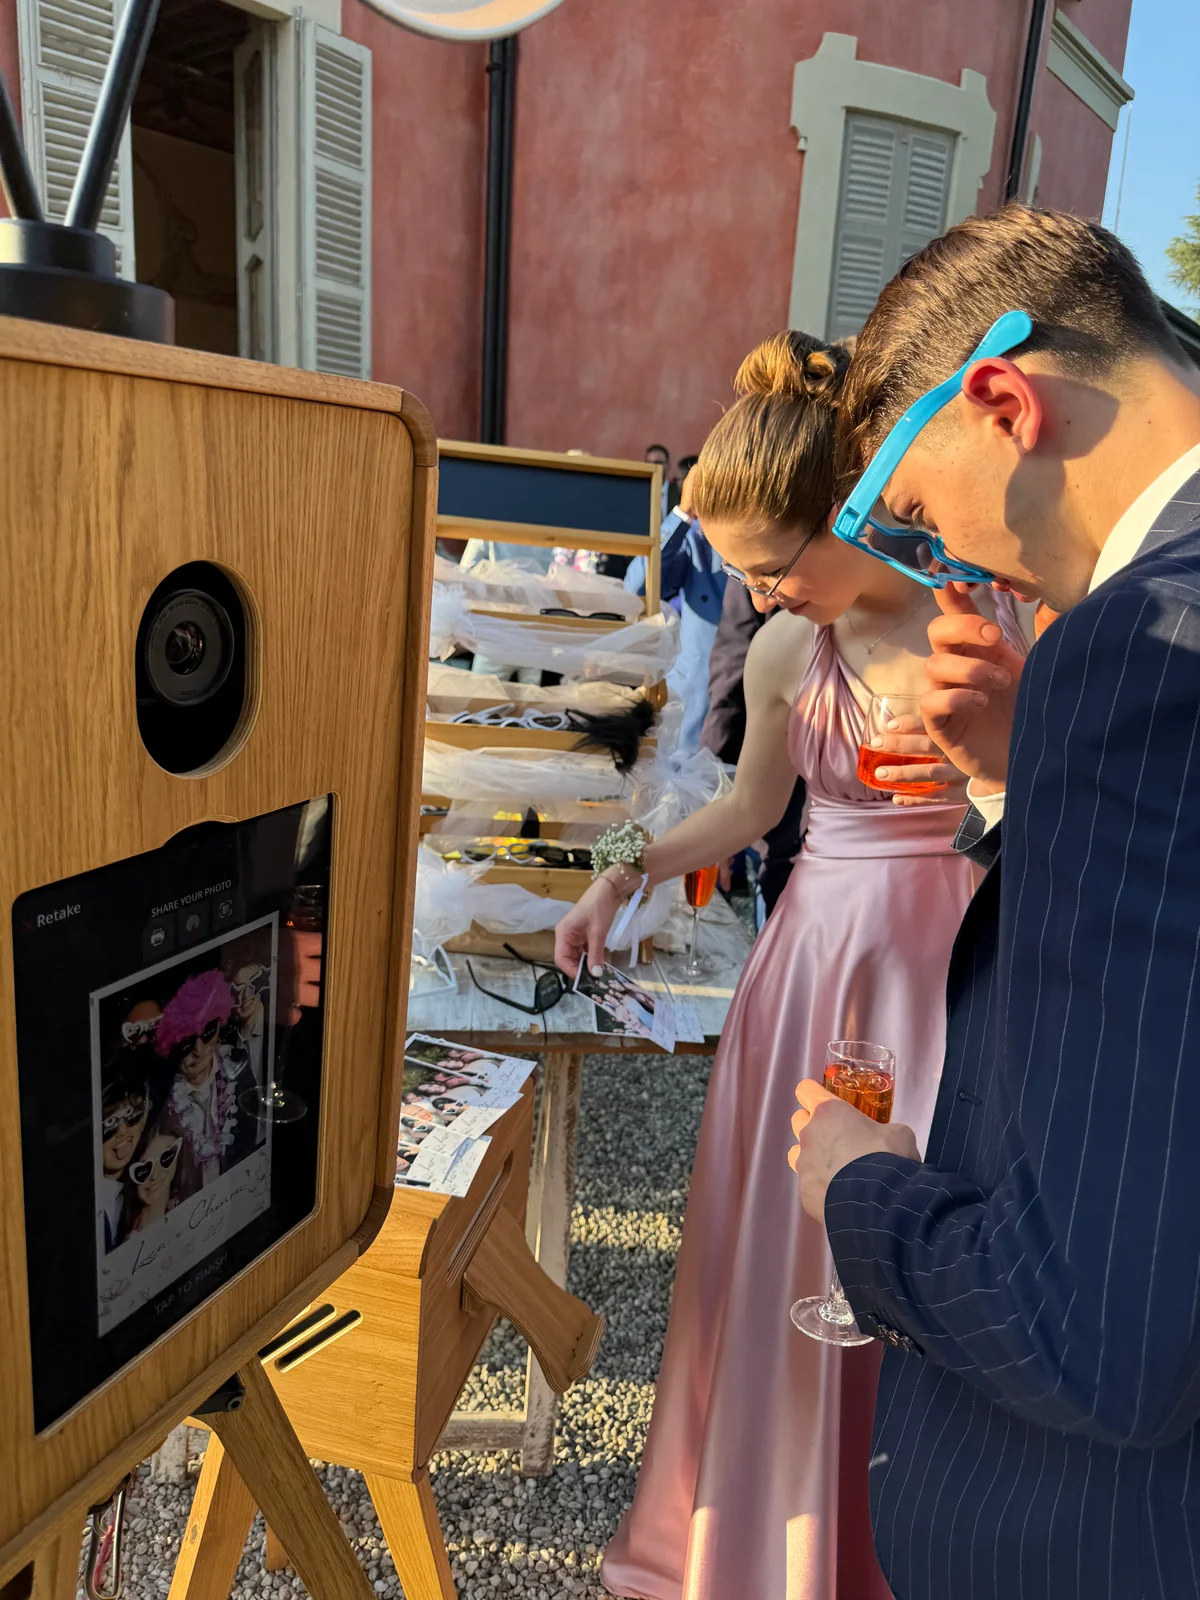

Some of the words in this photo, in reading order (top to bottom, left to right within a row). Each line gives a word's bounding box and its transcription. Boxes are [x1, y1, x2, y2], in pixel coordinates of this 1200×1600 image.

[37, 903, 82, 928] Retake
[151, 899, 179, 918] SHARE
[180, 890, 203, 907] YOUR
[204, 879, 232, 897] PHOTO
[154, 1292, 175, 1315] TAP
[177, 1280, 192, 1298] TO
[195, 1252, 228, 1284] FINISH
